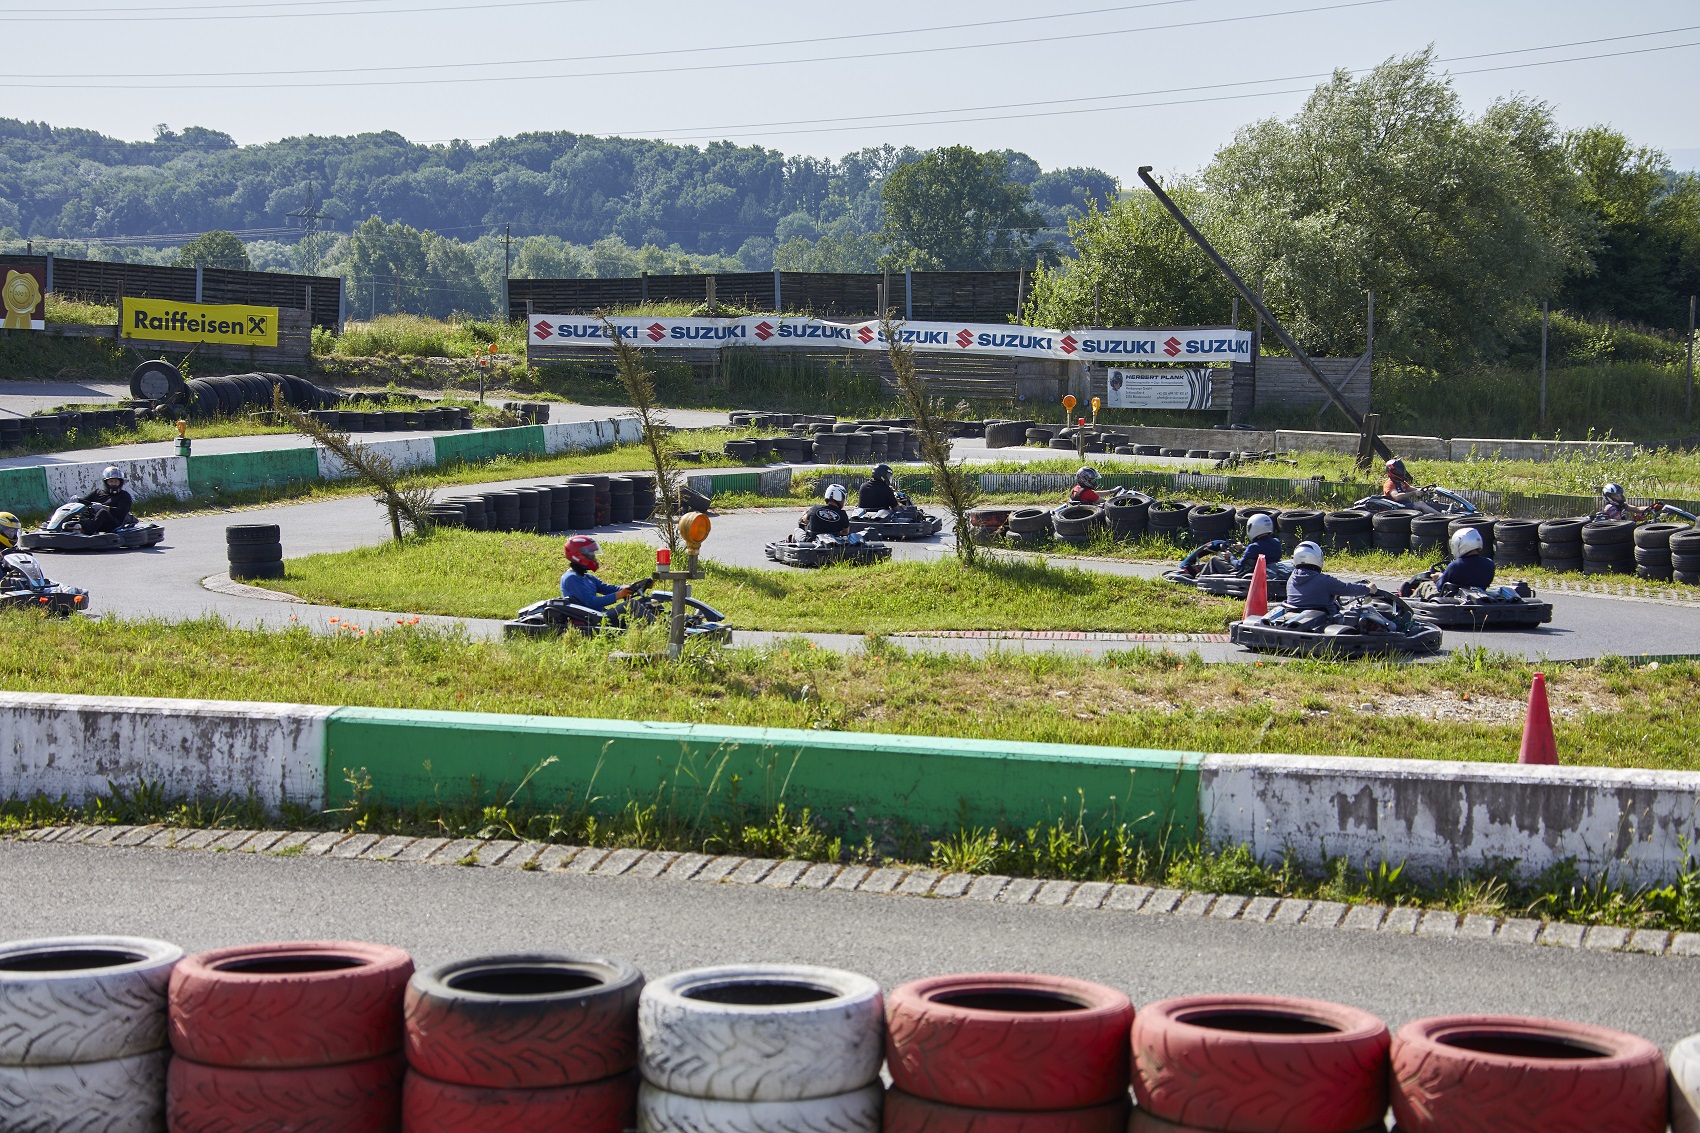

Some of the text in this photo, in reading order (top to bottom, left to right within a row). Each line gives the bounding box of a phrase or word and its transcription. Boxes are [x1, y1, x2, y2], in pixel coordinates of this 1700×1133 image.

[134, 310, 244, 335] Raiffeisen
[557, 324, 638, 339] SUZUKI
[670, 324, 746, 340] SUZUKI
[777, 324, 852, 340] SUZUKI
[977, 333, 1052, 350] SUZUKI
[1081, 339, 1156, 354] SUZUKI
[1185, 339, 1249, 354] SUZUKI
